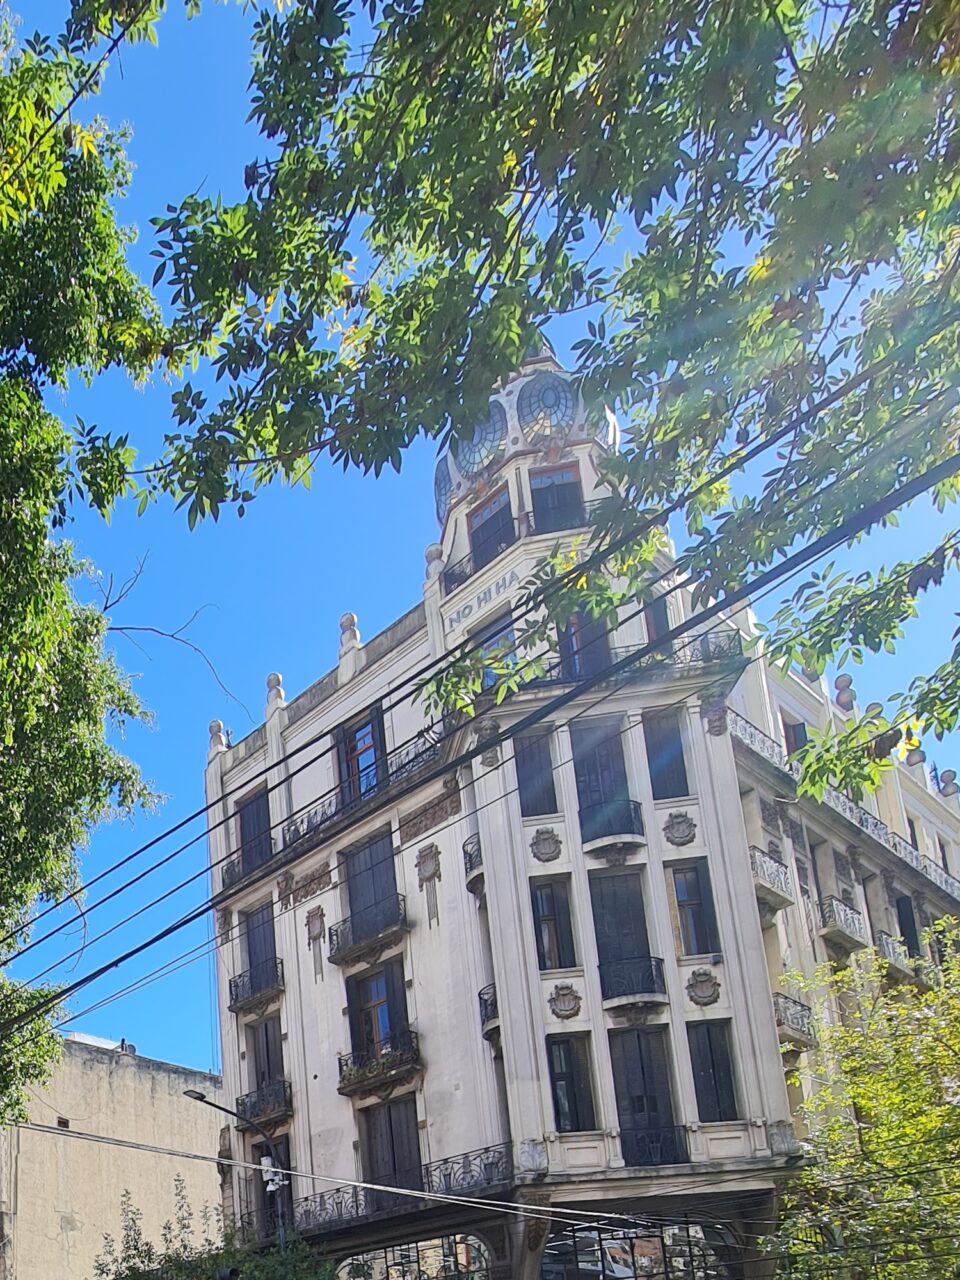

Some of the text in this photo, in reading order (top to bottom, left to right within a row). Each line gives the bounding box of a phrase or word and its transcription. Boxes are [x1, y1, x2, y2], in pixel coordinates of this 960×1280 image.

[449, 570, 519, 629] NO HI HA
